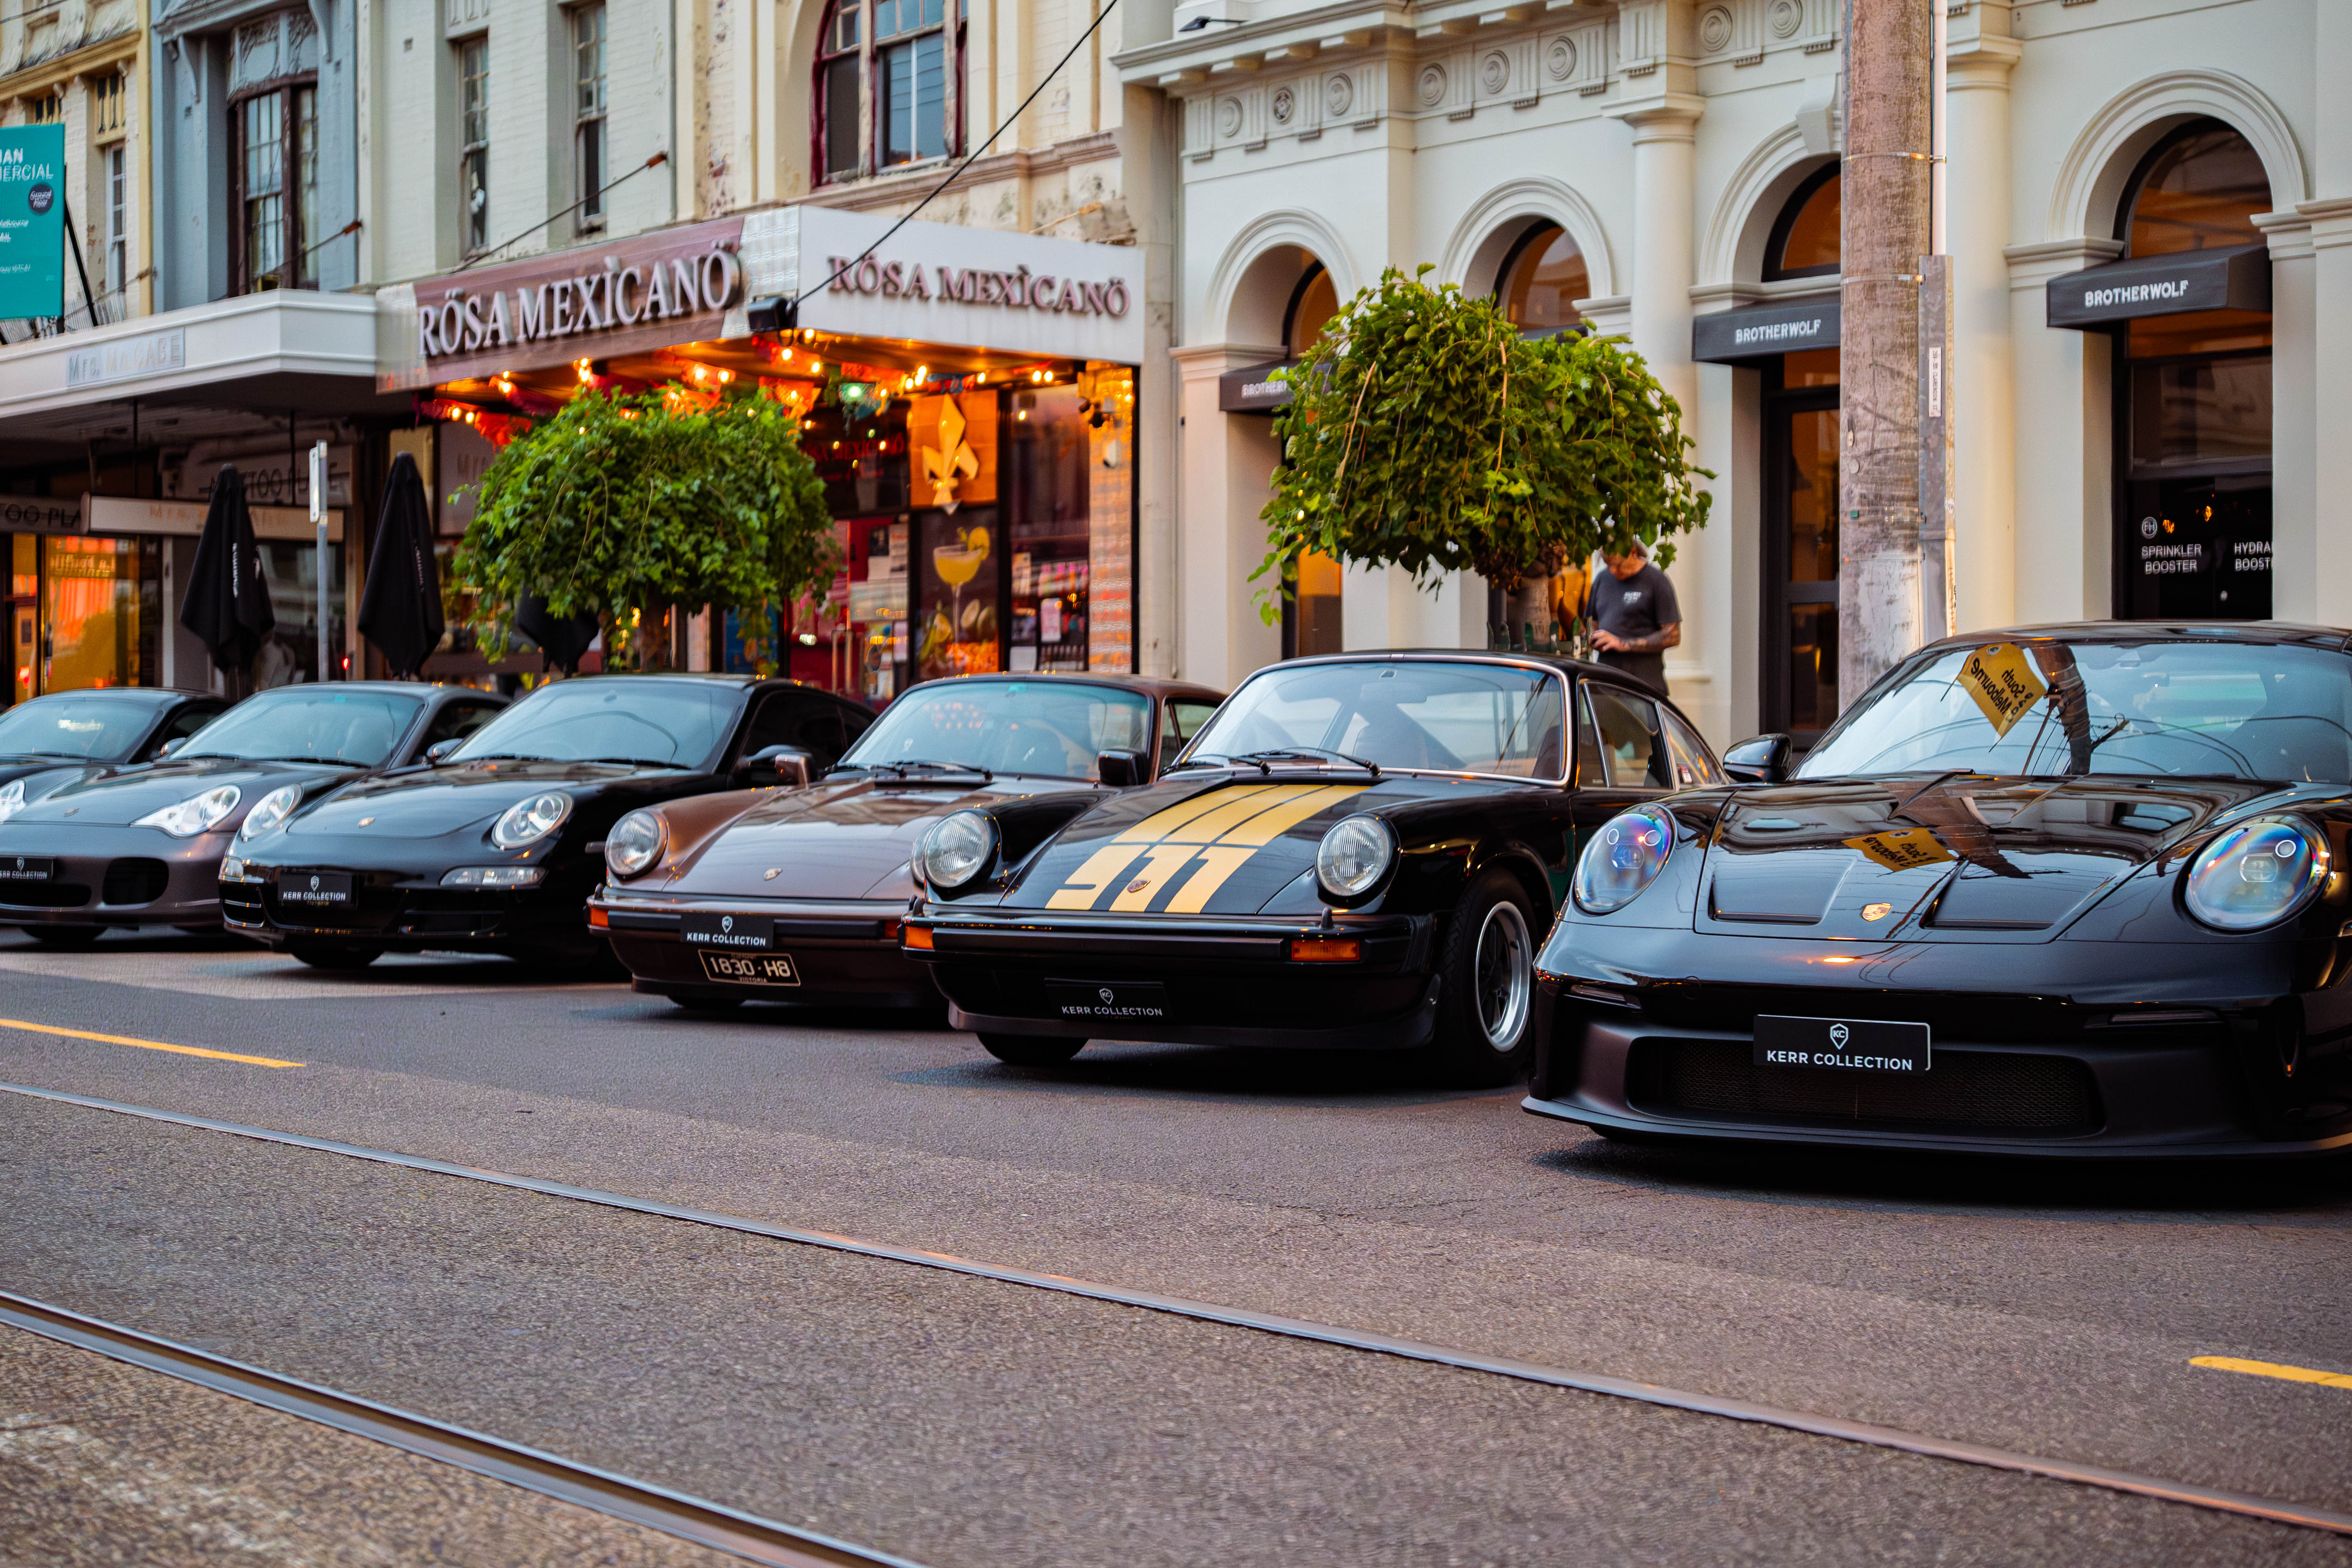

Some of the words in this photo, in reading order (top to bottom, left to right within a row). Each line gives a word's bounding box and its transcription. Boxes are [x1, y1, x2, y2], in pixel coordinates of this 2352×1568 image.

[0, 148, 23, 164] AN
[0, 163, 54, 181] ERCIAL
[2085, 280, 2189, 307] BROTHERWOLF
[1735, 319, 1822, 345] BROTHERWOLF
[1241, 380, 1287, 398] BROTHER
[2141, 544, 2202, 559] SPRINKLER
[2145, 559, 2197, 574] BOOSTER
[2235, 557, 2273, 571] BOOST
[283, 891, 302, 900] KERR
[303, 891, 346, 901] COLLECTION
[687, 932, 709, 942] KERR
[712, 934, 766, 946] COLLECTION
[1094, 1007, 1162, 1016] COLLECTION
[1833, 1030, 1845, 1038] KC
[1767, 1050, 1808, 1064] KERR
[1813, 1053, 1912, 1070] COLLECTION
